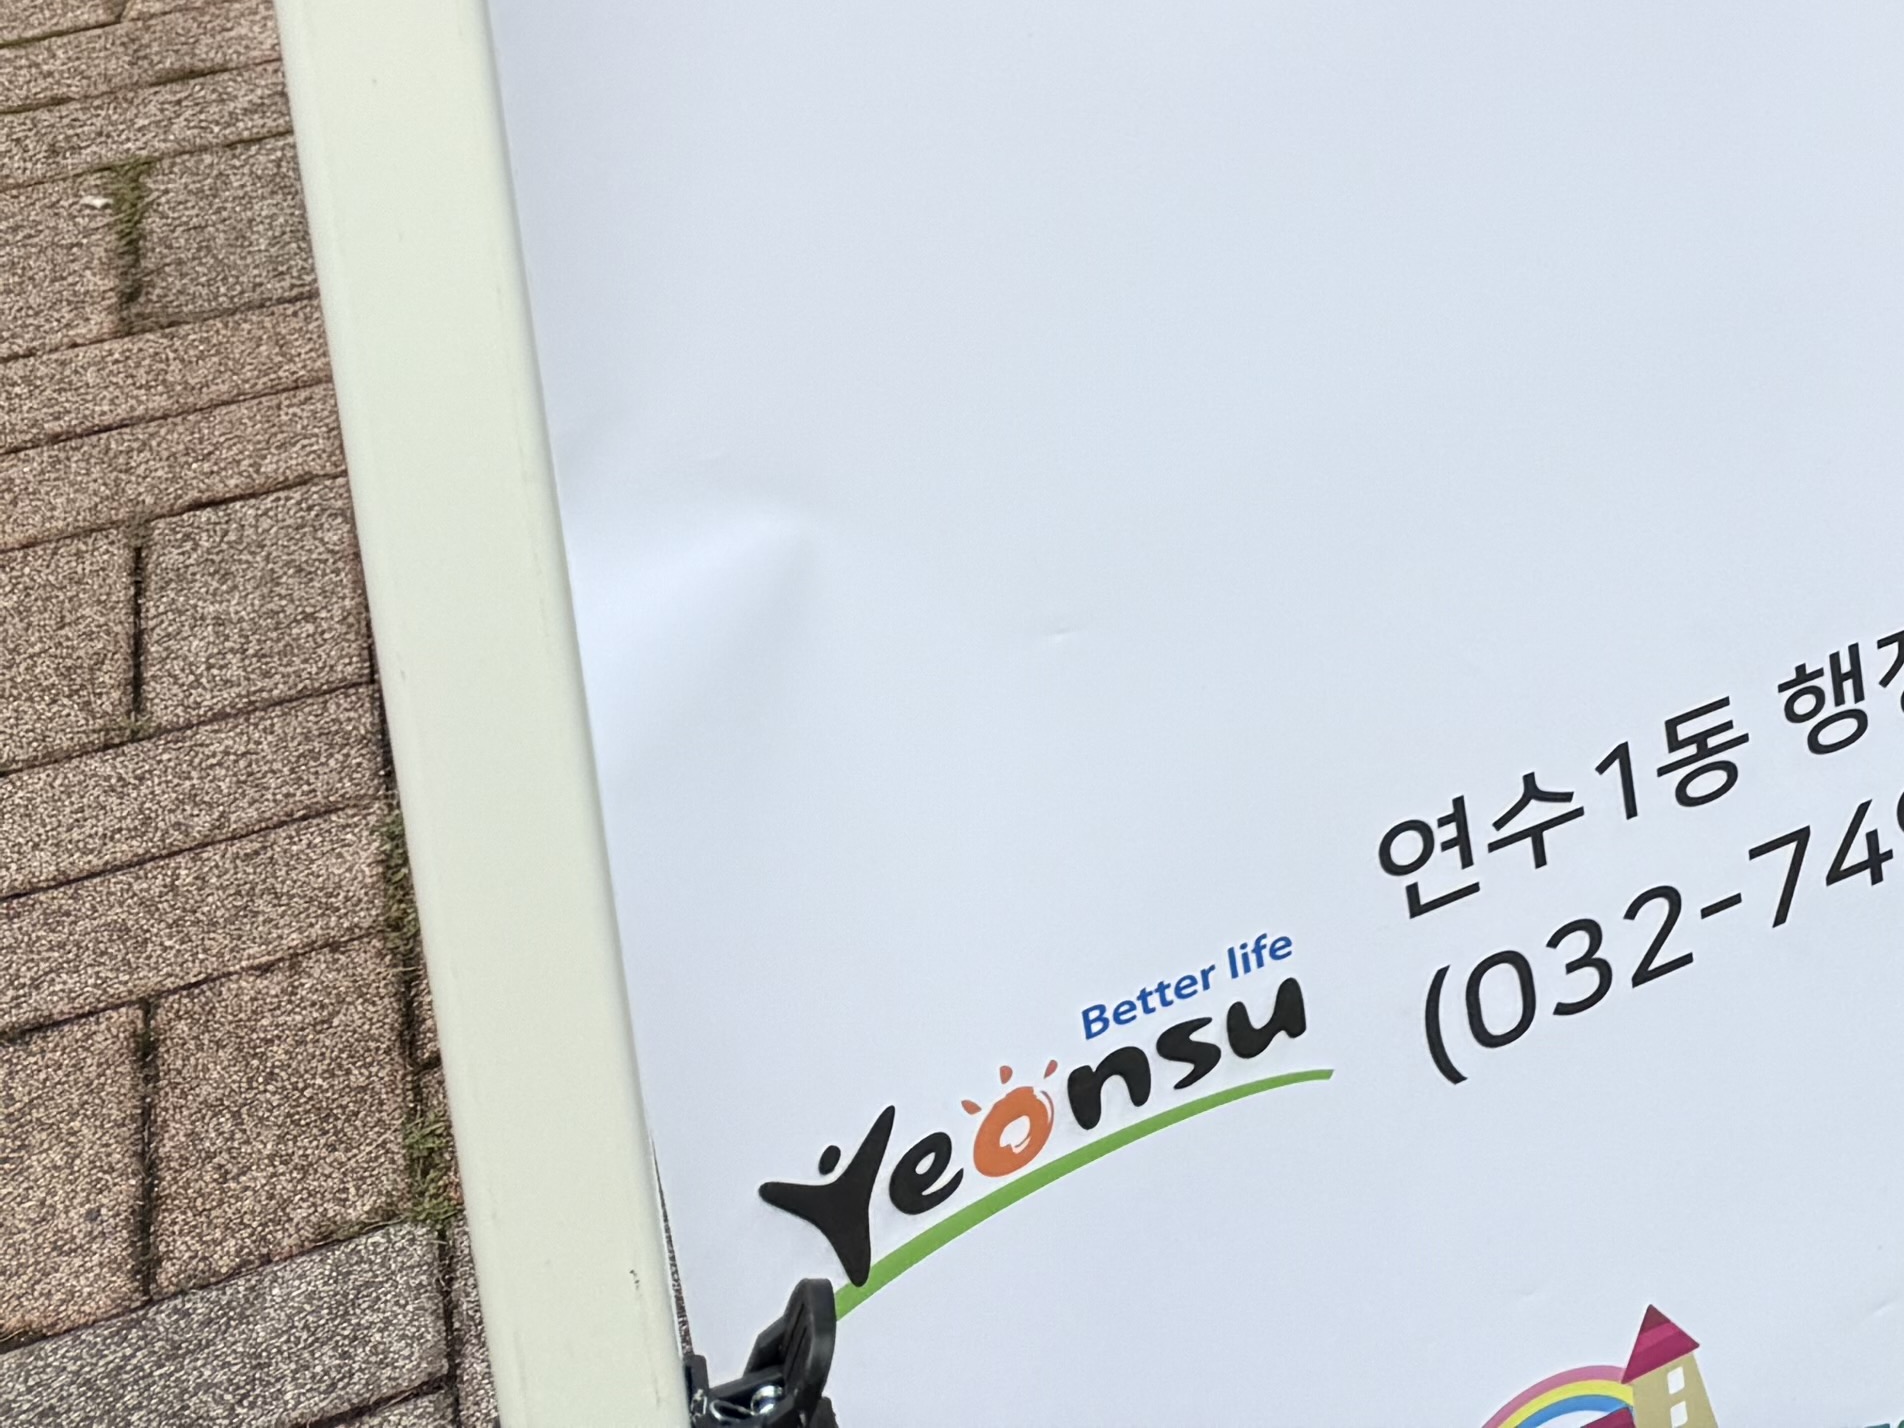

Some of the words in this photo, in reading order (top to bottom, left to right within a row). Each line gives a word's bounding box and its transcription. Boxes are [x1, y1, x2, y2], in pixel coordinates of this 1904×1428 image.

[1378, 695, 1750, 919] 연수1동
[1081, 964, 1216, 1040] Better
[1227, 933, 1293, 980] life
[758, 977, 1307, 1287] Yeonsu
